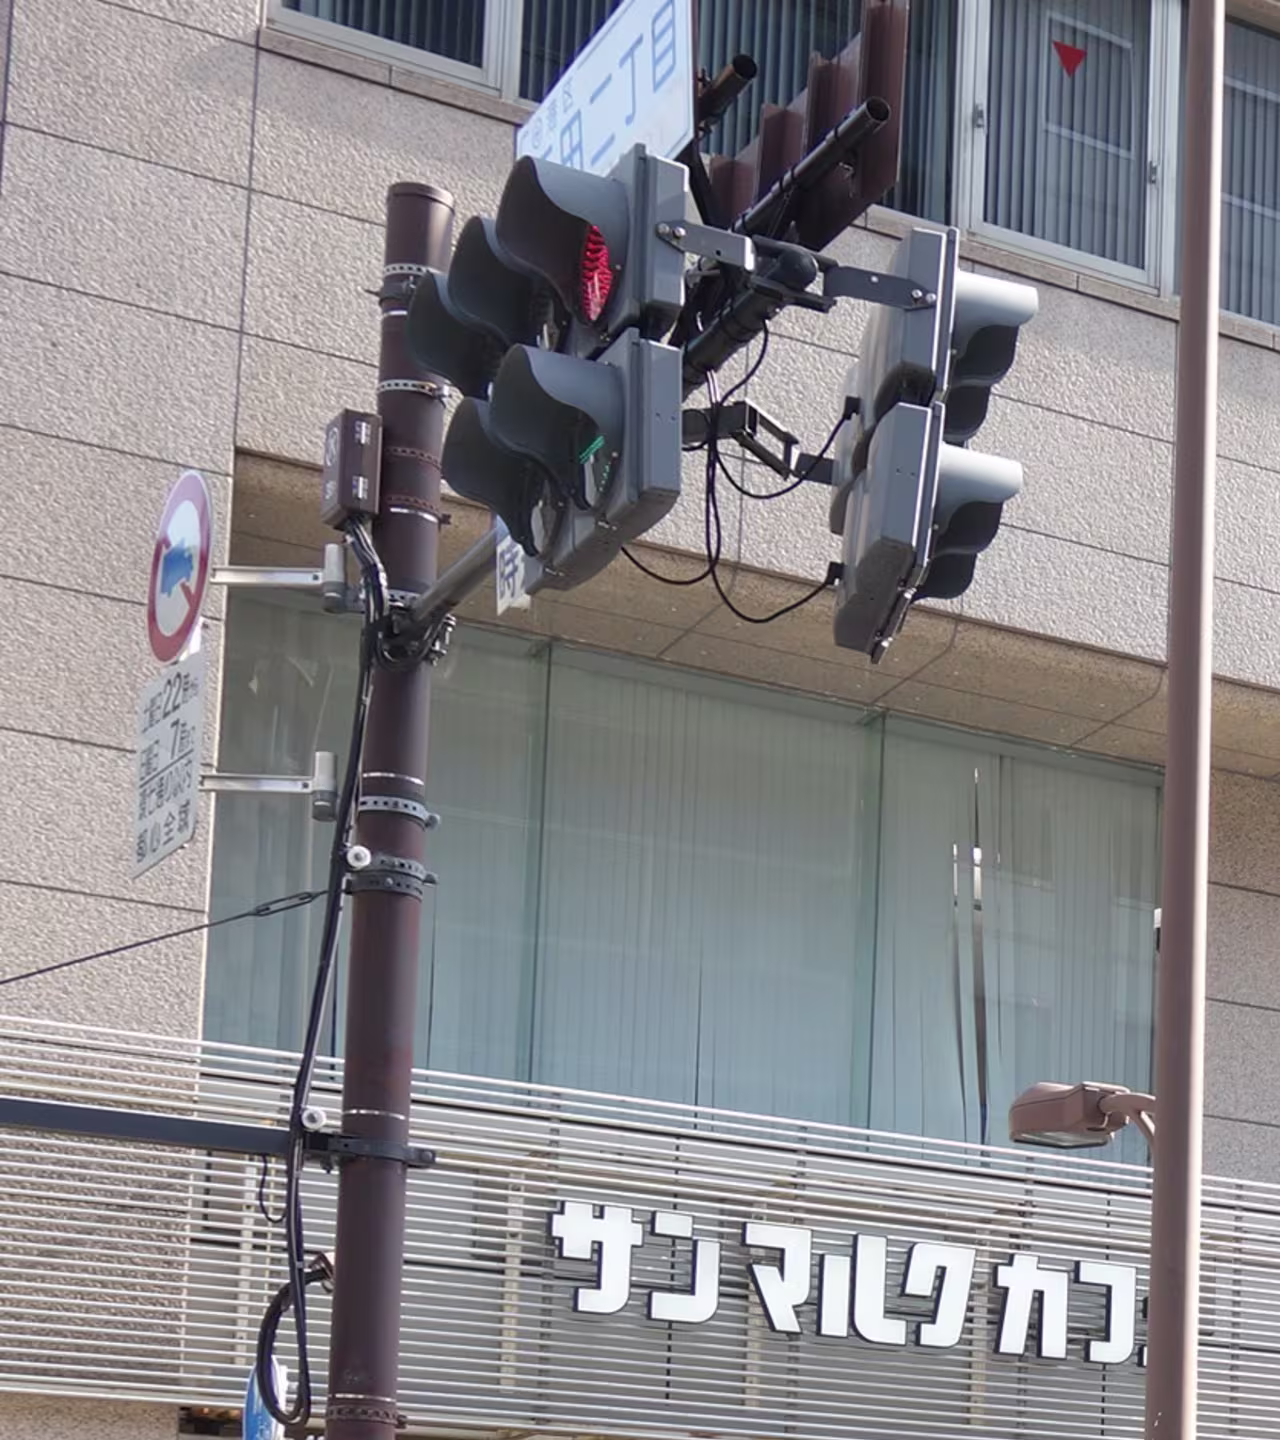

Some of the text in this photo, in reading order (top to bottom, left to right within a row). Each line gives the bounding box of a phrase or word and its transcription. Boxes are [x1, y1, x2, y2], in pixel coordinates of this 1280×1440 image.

[543, 0, 677, 170] 田二丁目
[550, 1199, 1148, 1367] サンマルクカフ
